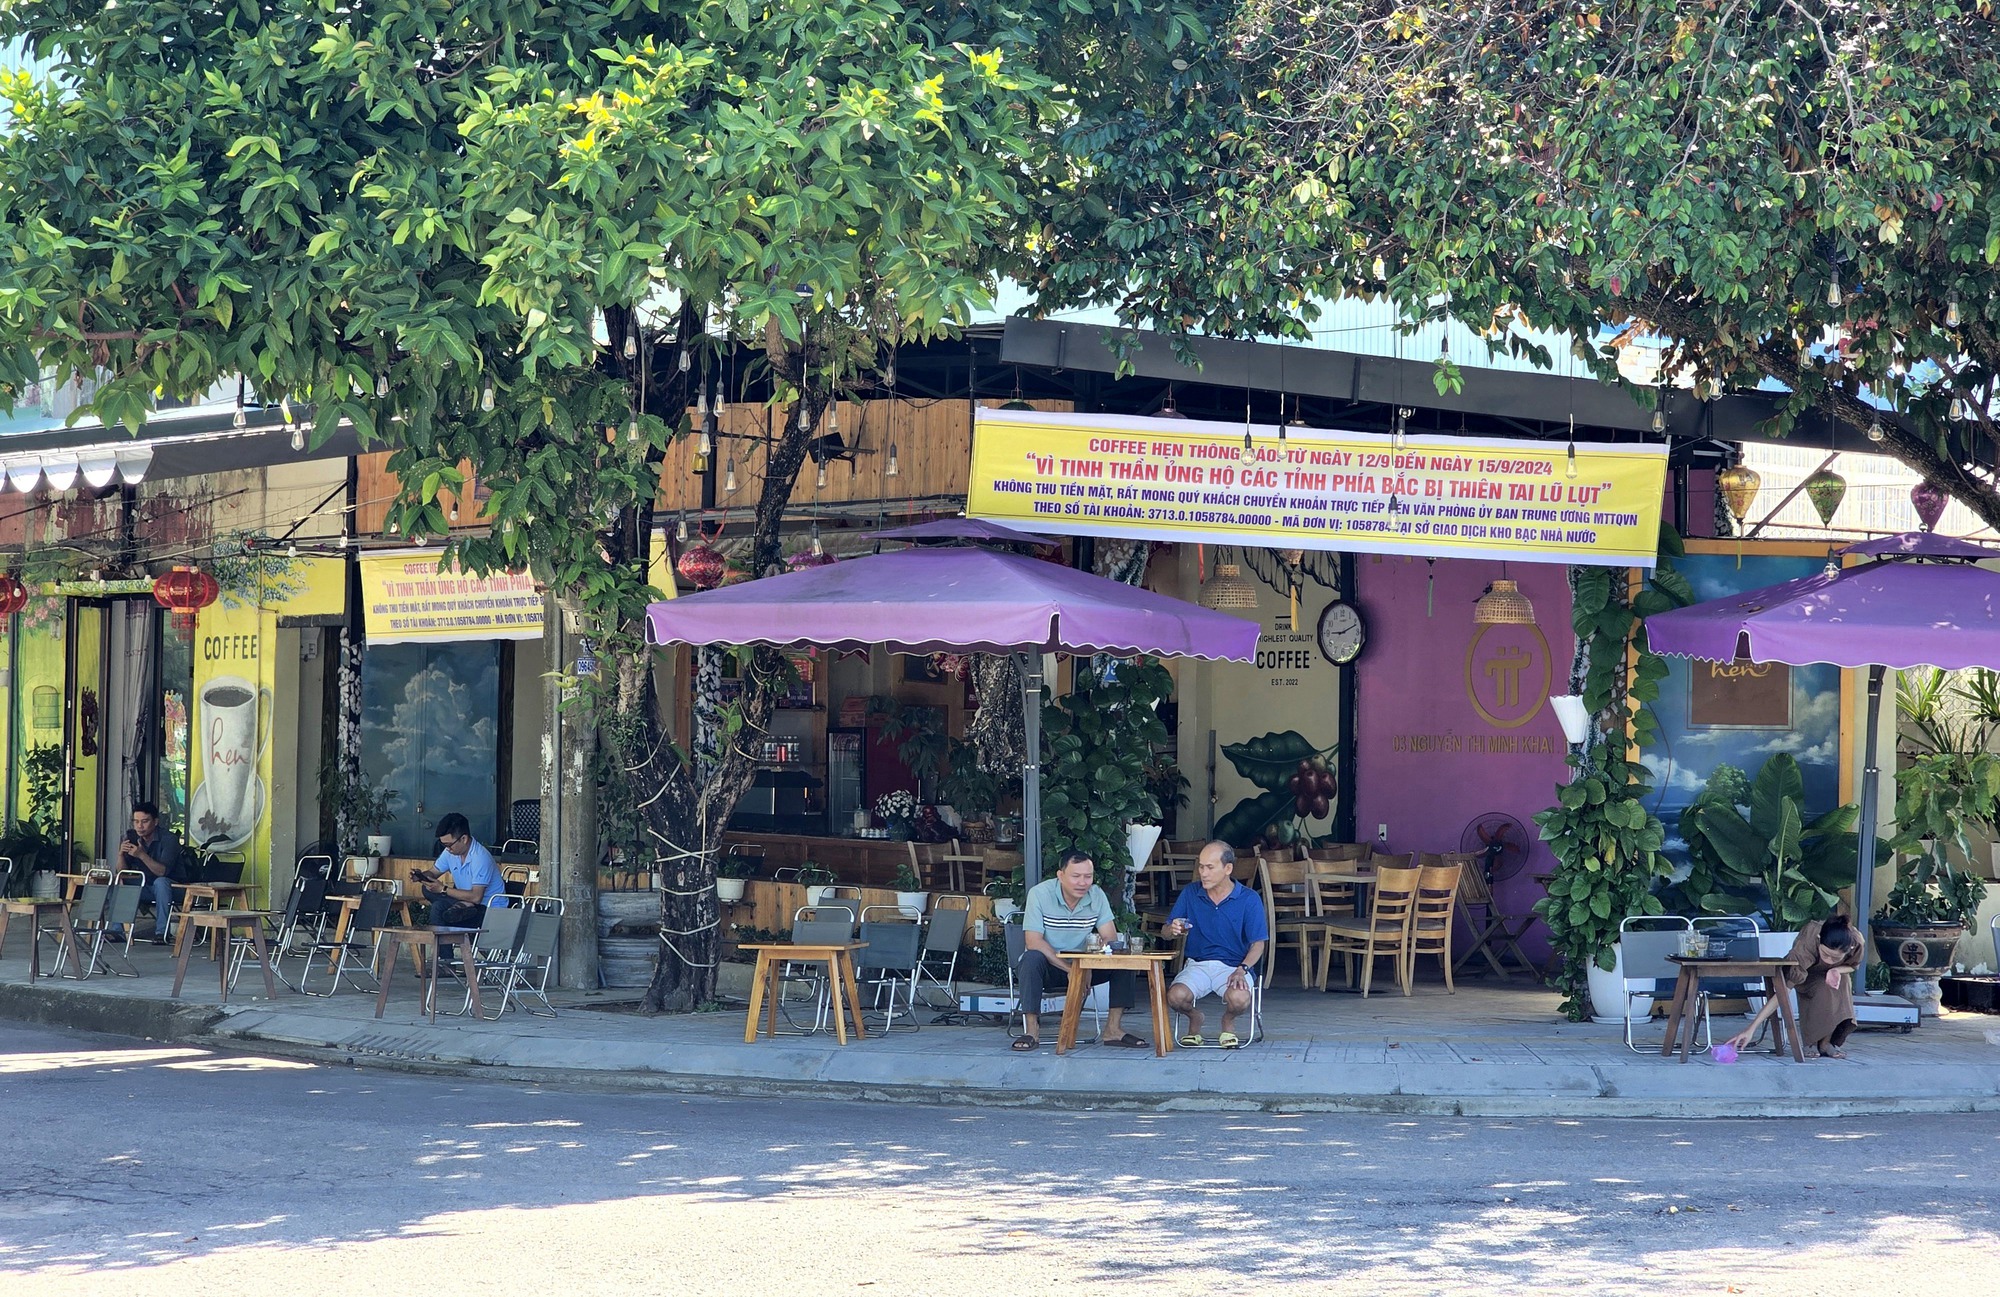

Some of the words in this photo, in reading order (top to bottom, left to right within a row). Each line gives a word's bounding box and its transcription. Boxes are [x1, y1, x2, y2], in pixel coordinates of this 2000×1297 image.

[1089, 438, 1146, 459] COFFEE
[1151, 442, 1183, 459] HẸN
[1189, 443, 1240, 460] THÔNG
[1287, 448, 1307, 463] TỪ
[1310, 449, 1352, 466] NGÀY
[1357, 453, 1389, 467] 12/9
[1394, 451, 1425, 469] ĐẾN
[1430, 457, 1472, 471] NGÀY
[1478, 459, 1552, 474] 15/9/2024
[1060, 459, 1102, 477] TINH
[1109, 458, 1158, 480] THẦN
[1165, 460, 1203, 483] ỦNG
[1209, 465, 1234, 488] HỘ
[1240, 463, 1277, 487] CÁC
[1284, 467, 1326, 490] TỈNH
[1332, 472, 1374, 493] PHÍA
[1382, 471, 1418, 496] BẮC
[1425, 479, 1442, 500] BỊ
[1449, 478, 1502, 499] THIÊN
[1508, 483, 1534, 500] TAI
[1539, 482, 1562, 502] LŨ
[994, 479, 1032, 493] KHÔNG
[1035, 482, 1056, 494] THU
[1060, 481, 1084, 496] TIỀN
[1088, 484, 1113, 500] MẶT,
[1117, 486, 1138, 499] RẤT
[1141, 489, 1174, 501] MONG
[1178, 491, 1200, 503] QUÝ
[1202, 493, 1240, 505] KHÁCH
[1243, 492, 1287, 508] CHUYỂN
[1290, 495, 1327, 510] KHOẢN
[1330, 500, 1358, 513] TRỰC
[1361, 500, 1385, 513] TIẾP
[1413, 502, 1435, 515] VĂN
[1438, 503, 1475, 517] PHÒNG
[1478, 504, 1492, 518] ỦY
[1495, 508, 1518, 519] BAN
[1521, 509, 1556, 521] TRUNG
[1560, 509, 1590, 523] ƯƠNG
[1593, 512, 1637, 526] MTTQVN
[1033, 501, 1061, 513] THEO
[1064, 500, 1080, 514] SỐ
[1083, 502, 1100, 516] TÀI
[1103, 503, 1144, 518] KHOẢN:
[1148, 508, 1271, 525] 3713.0.1058784.00000
[1282, 514, 1299, 527] MÃ
[1303, 517, 1326, 528] ĐƠN
[1329, 518, 1342, 531] VỊ:
[1414, 519, 1430, 534] SỞ
[1432, 523, 1457, 535] GIAO
[1461, 524, 1486, 537] DỊCH
[1490, 526, 1511, 538] KHO
[1515, 528, 1536, 542] BẠC
[1540, 529, 1562, 541] NHÀ
[1566, 529, 1596, 543] NƯỚC
[404, 563, 428, 575] COFFEE
[396, 582, 414, 597] TINH
[204, 635, 257, 661] COFFEE
[1257, 651, 1309, 669] COFFEE
[211, 717, 249, 772] hẹn
[1393, 735, 1406, 752] 03
[1409, 728, 1462, 752] NGUYỄN
[1488, 735, 1519, 753] MINH
